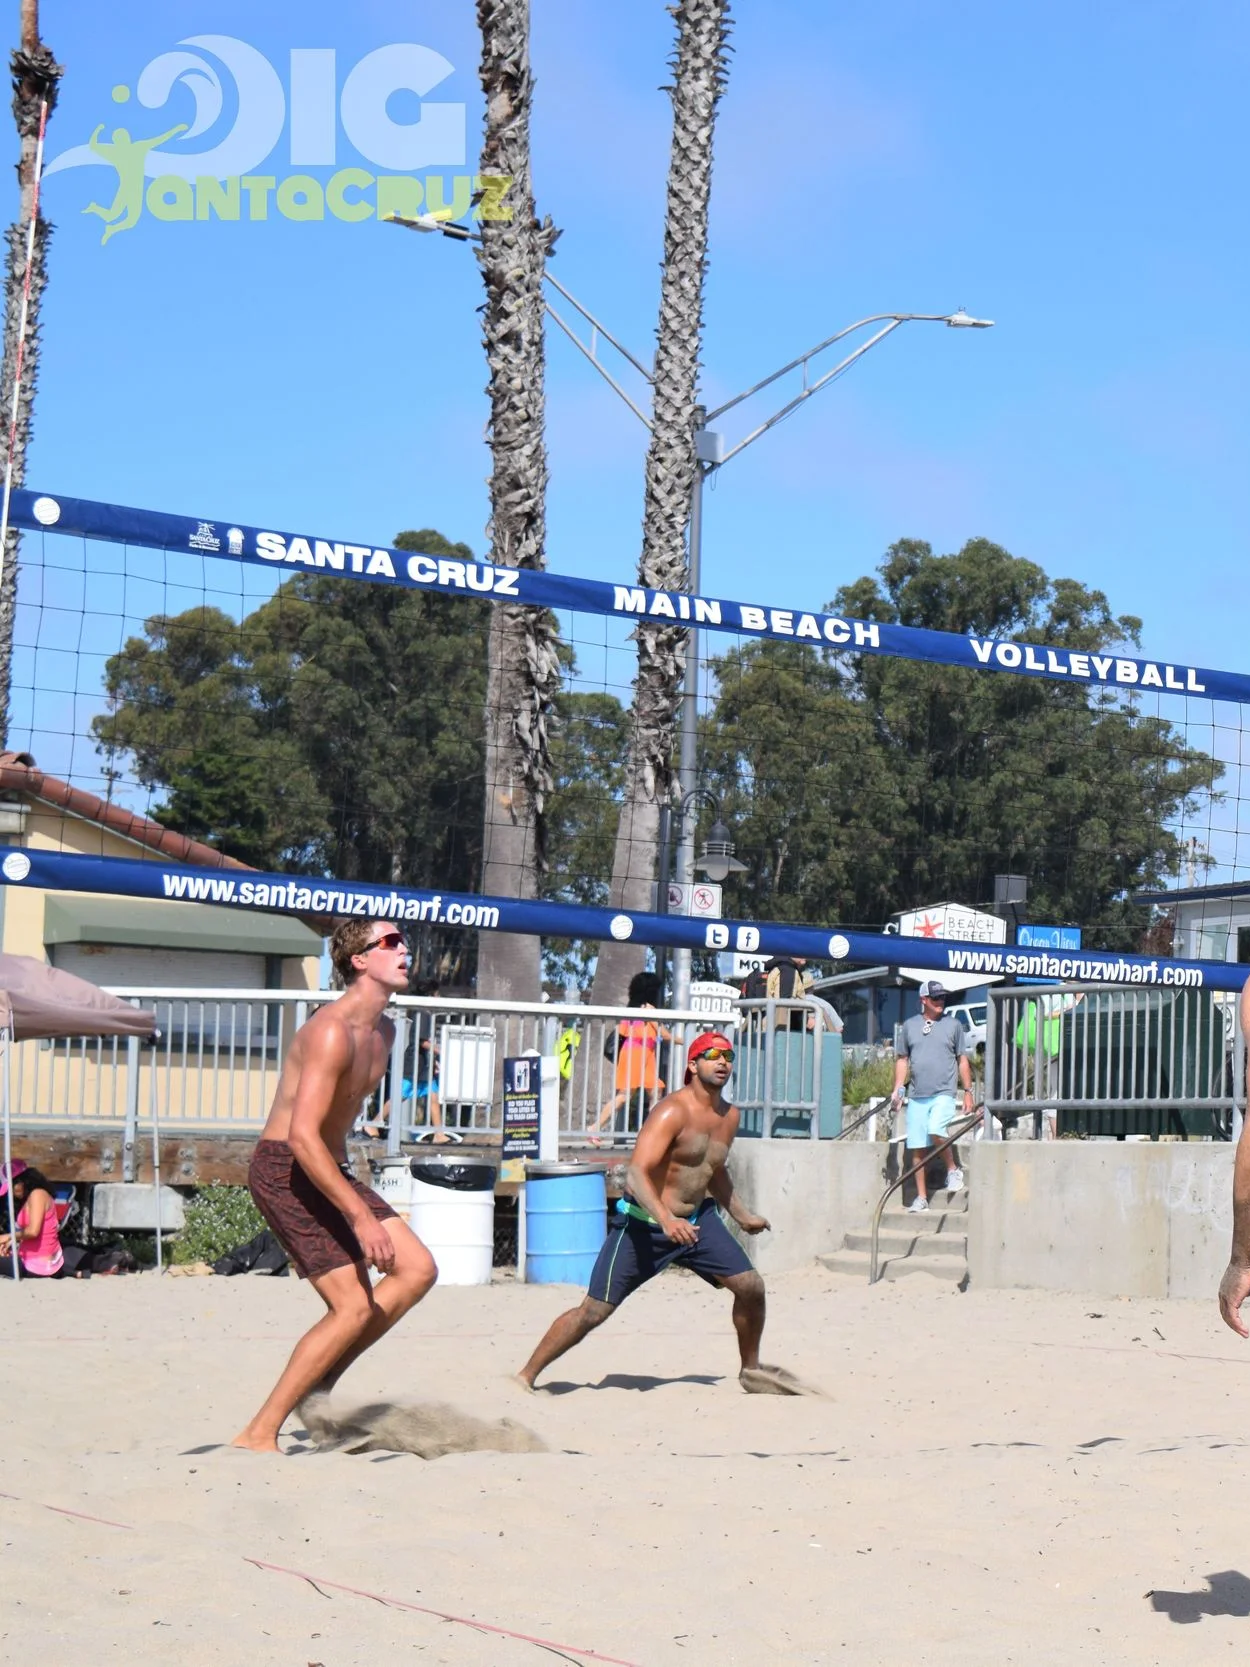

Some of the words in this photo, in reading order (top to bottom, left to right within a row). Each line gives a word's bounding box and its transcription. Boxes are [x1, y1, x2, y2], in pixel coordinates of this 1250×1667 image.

[256, 531, 396, 578] SANTA
[408, 555, 520, 596] CRUZ
[614, 586, 722, 625] MAIN
[740, 605, 880, 648] BEACH
[970, 639, 1206, 693] VOLLEYBALL
[163, 873, 500, 928] www.santacruzwharf.com
[948, 916, 995, 930] BEACH
[948, 930, 994, 943] STREET
[948, 949, 1203, 987] www.santacruzwharf.com
